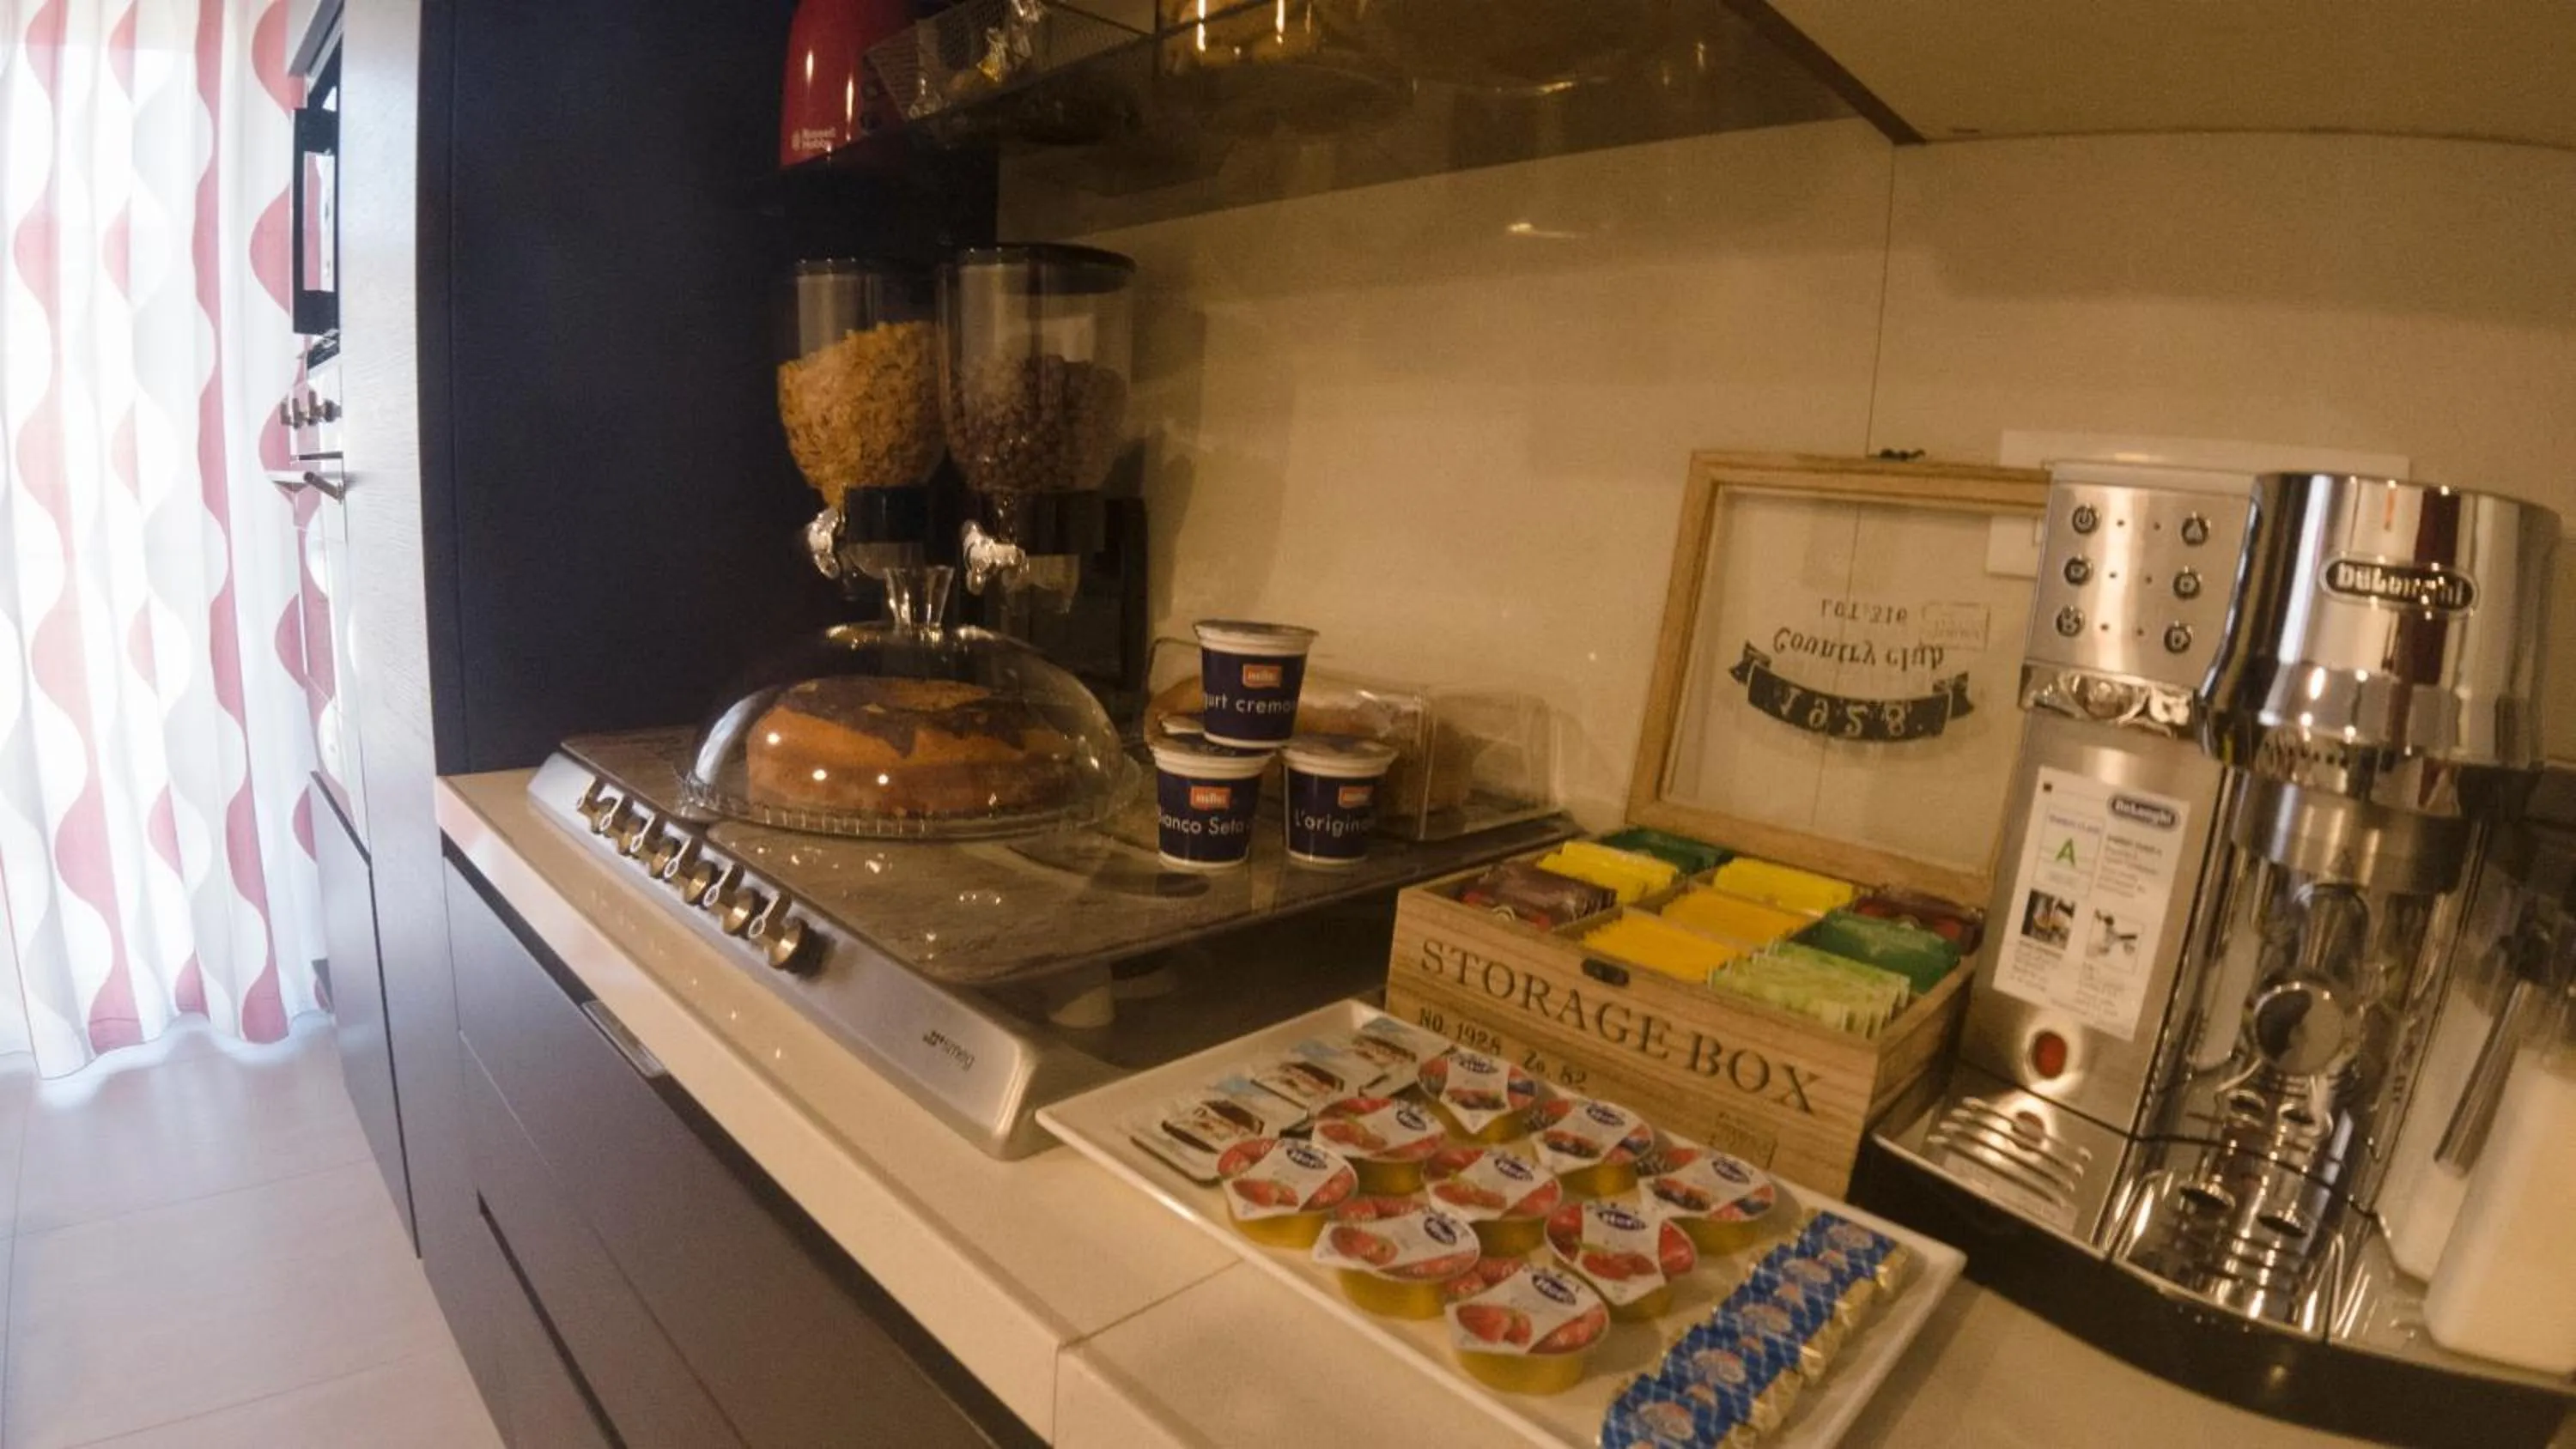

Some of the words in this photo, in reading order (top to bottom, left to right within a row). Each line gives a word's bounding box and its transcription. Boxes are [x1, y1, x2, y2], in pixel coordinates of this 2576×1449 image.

[2056, 837, 2077, 868] A
[1421, 939, 1671, 1061] STORAGE
[1686, 1033, 1820, 1114] BOX
